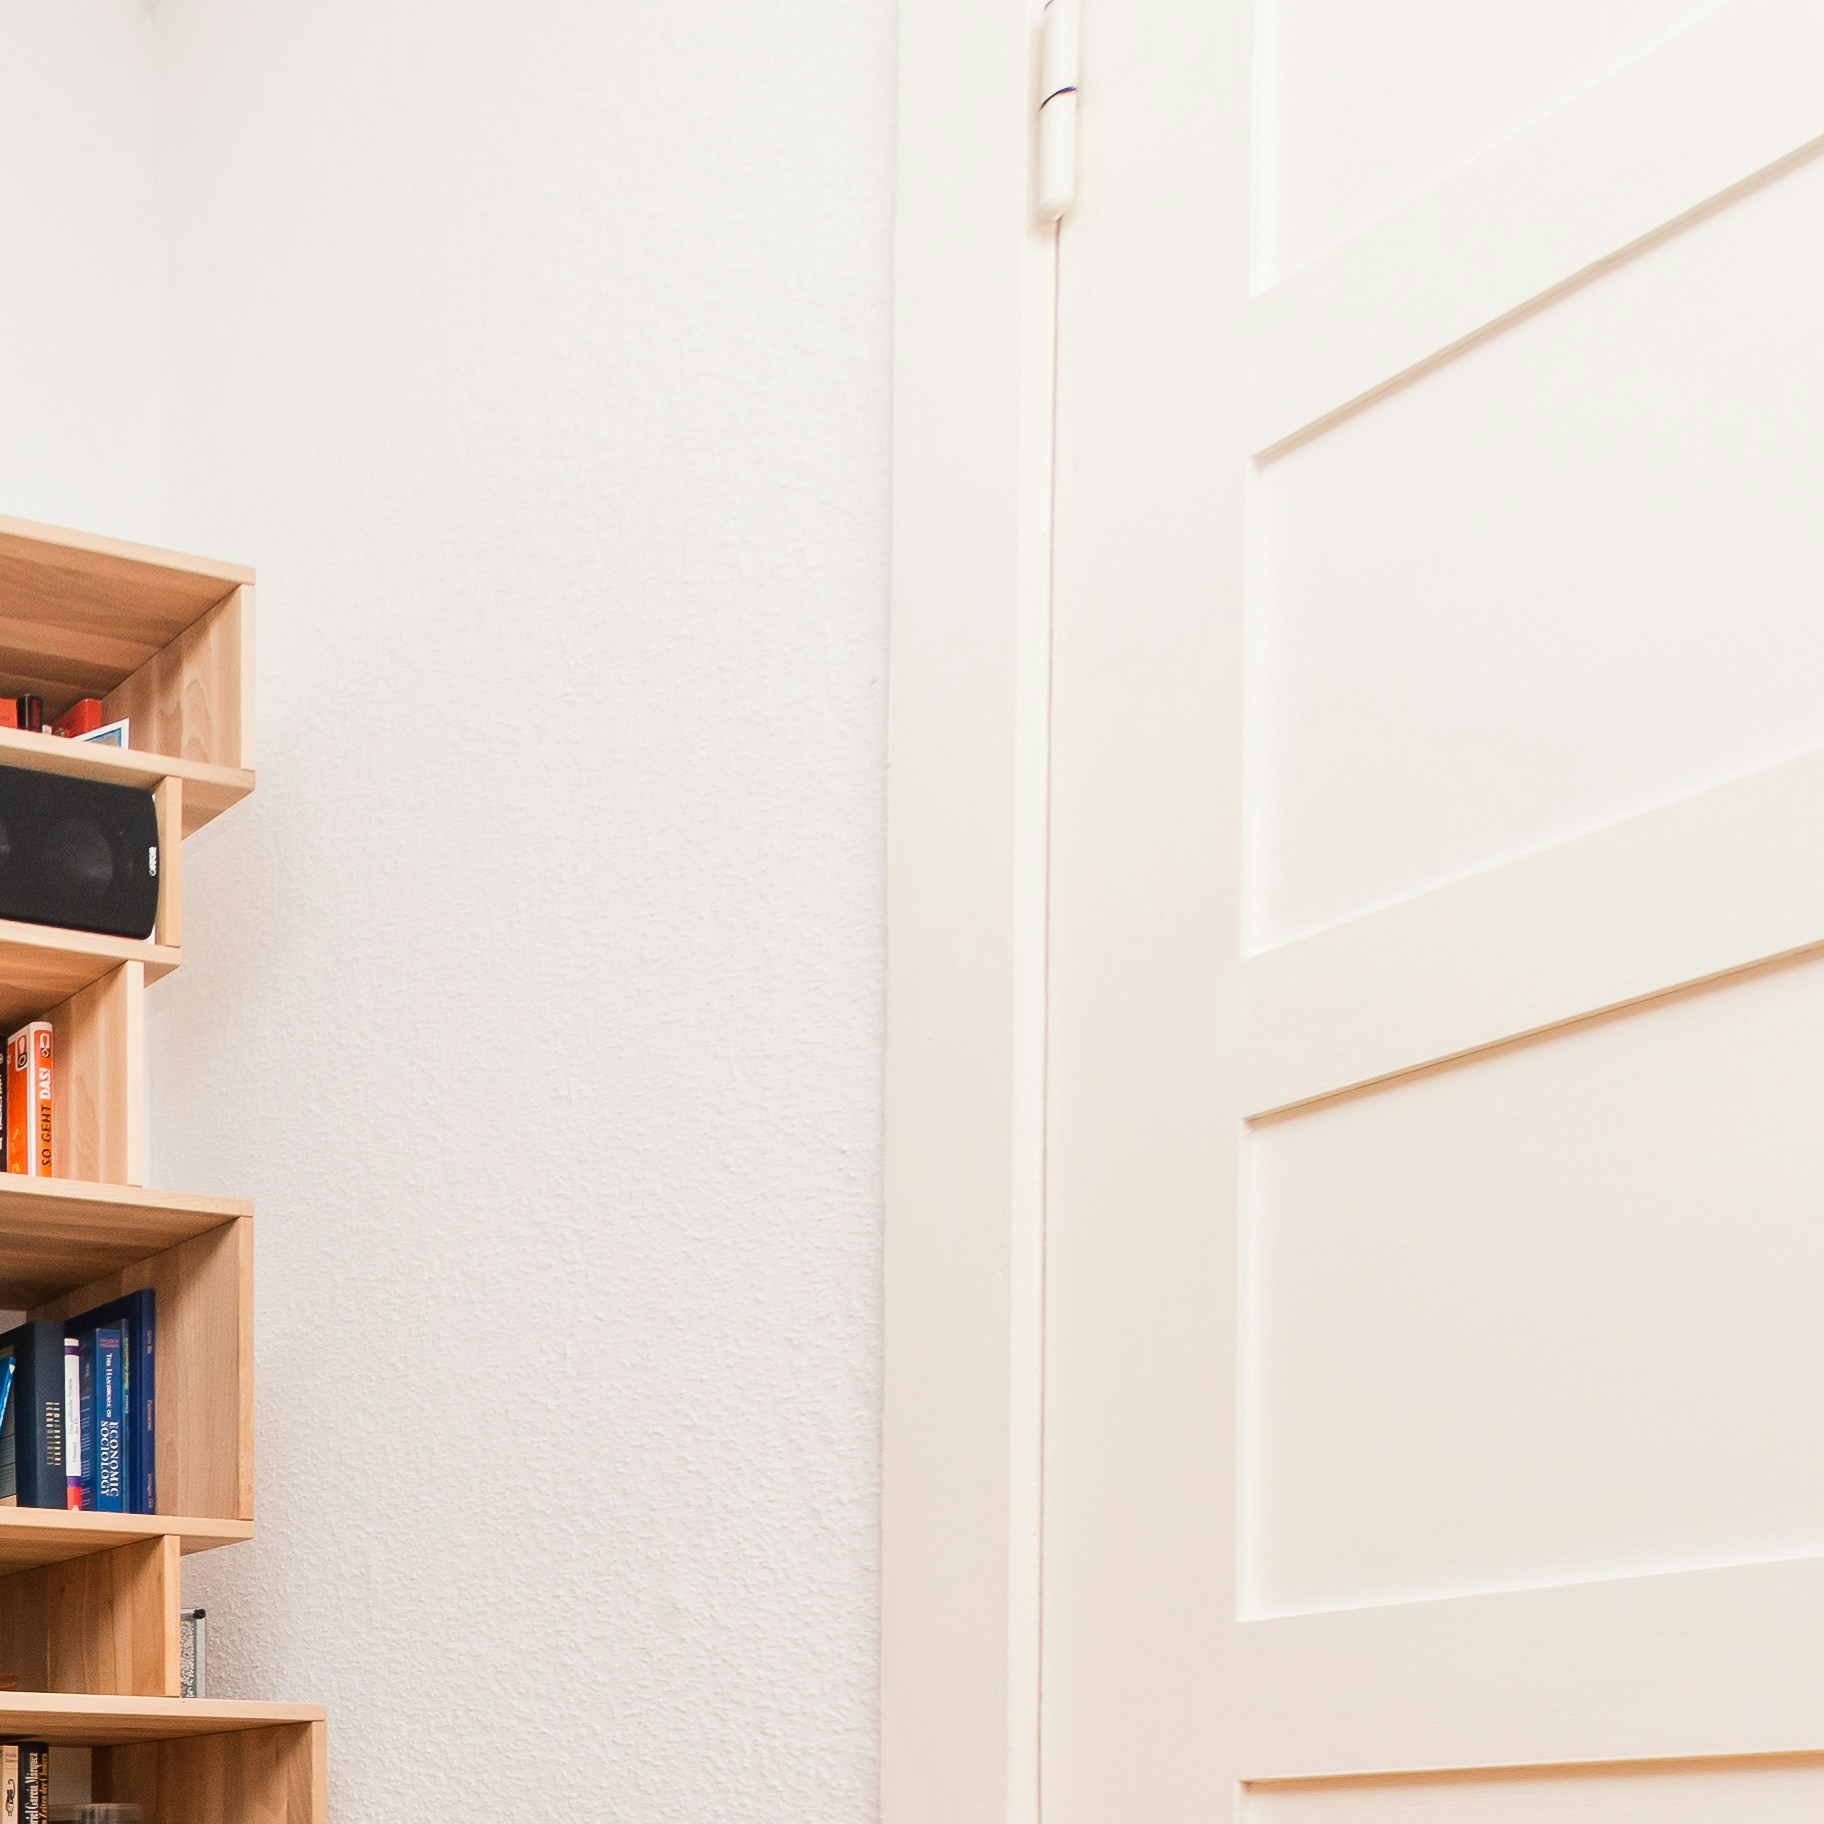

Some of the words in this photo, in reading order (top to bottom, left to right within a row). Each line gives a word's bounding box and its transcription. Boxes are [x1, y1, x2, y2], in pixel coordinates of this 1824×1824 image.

[38, 1066, 51, 1100] DAS!
[40, 1103, 51, 1143] GEHT
[41, 1148, 51, 1168] SO
[100, 1420, 110, 1498] SOCIOLOGY
[108, 1421, 119, 1497] ECONOMIC
[38, 1795, 48, 1819] Zeiten
